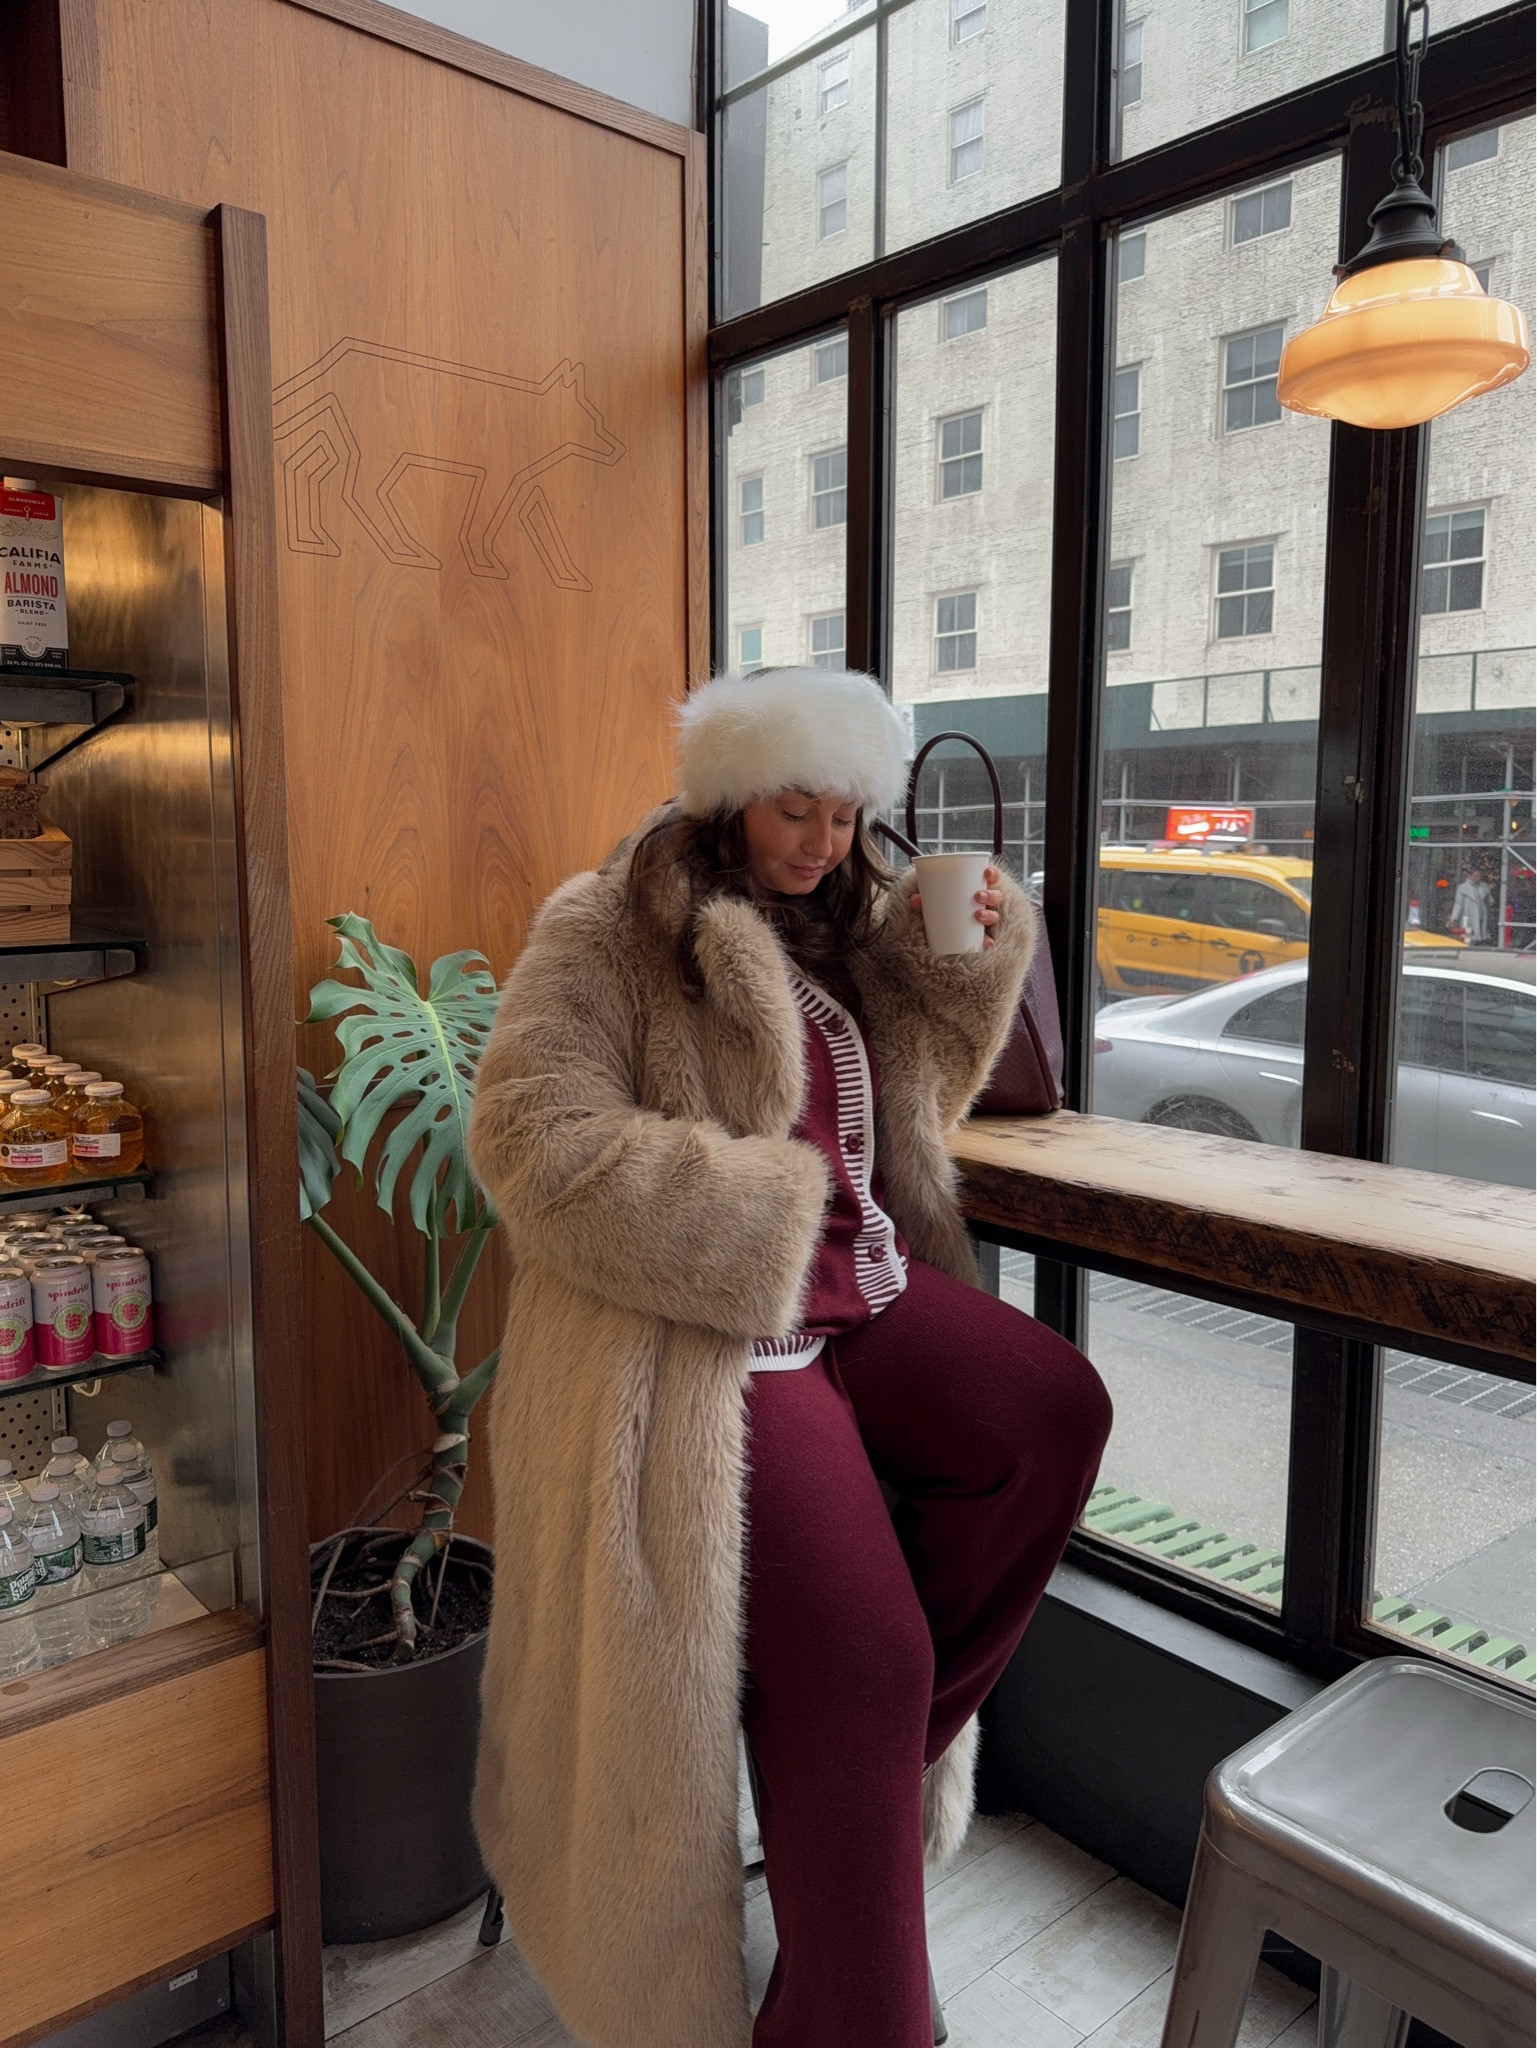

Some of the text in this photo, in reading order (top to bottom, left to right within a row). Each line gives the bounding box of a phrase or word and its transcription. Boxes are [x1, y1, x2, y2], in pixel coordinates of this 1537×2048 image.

[0, 547, 61, 565] CALIFIA
[12, 560, 48, 569] FARMS
[4, 571, 59, 598] ALMOND
[7, 599, 57, 612] BARISTA
[106, 1273, 148, 1291] spindrift
[48, 1283, 89, 1301] spindrift
